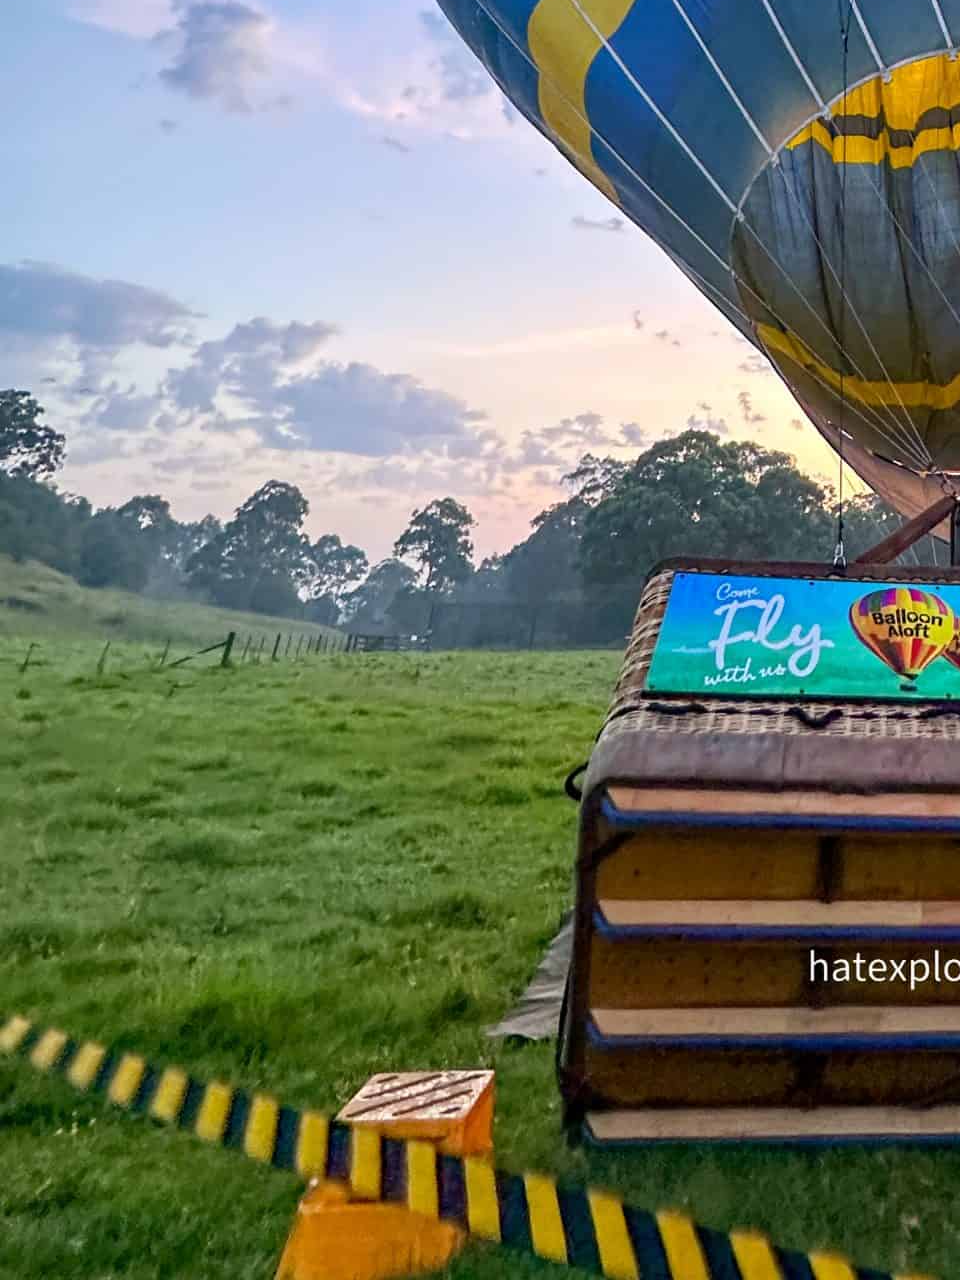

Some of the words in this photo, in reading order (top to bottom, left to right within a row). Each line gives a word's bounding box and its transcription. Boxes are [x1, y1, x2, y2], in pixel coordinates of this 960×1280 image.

[716, 583, 760, 601] Come
[872, 608, 944, 626] Balloon
[708, 594, 835, 677] Fly
[888, 624, 929, 639] Aloft
[704, 657, 757, 685] with
[758, 664, 787, 678] us
